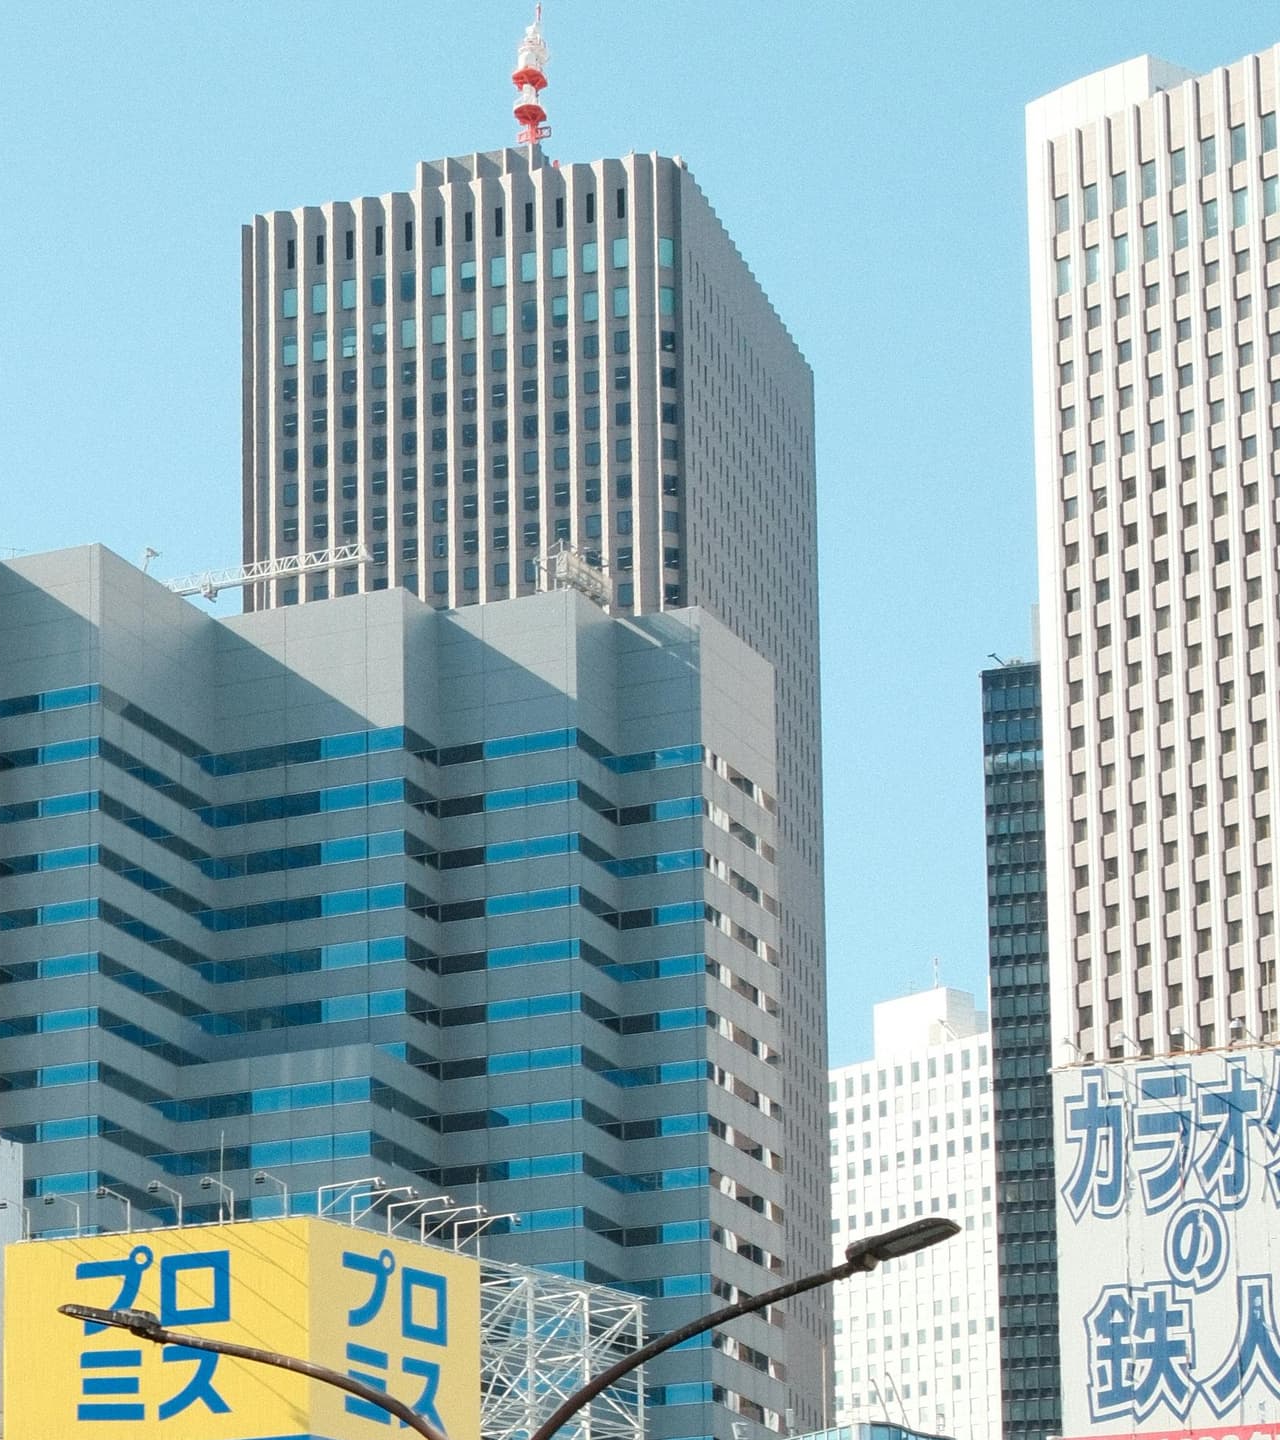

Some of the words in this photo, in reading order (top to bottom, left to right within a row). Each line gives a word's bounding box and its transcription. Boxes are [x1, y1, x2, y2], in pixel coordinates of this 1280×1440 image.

[1060, 1054, 1280, 1225] カラオ
[75, 1244, 233, 1337] プロ
[1164, 1198, 1231, 1291] の
[341, 1247, 449, 1348] プロ
[76, 1344, 233, 1423] ミス
[344, 1342, 448, 1435] ミス
[1082, 1272, 1280, 1424] 鉄人
